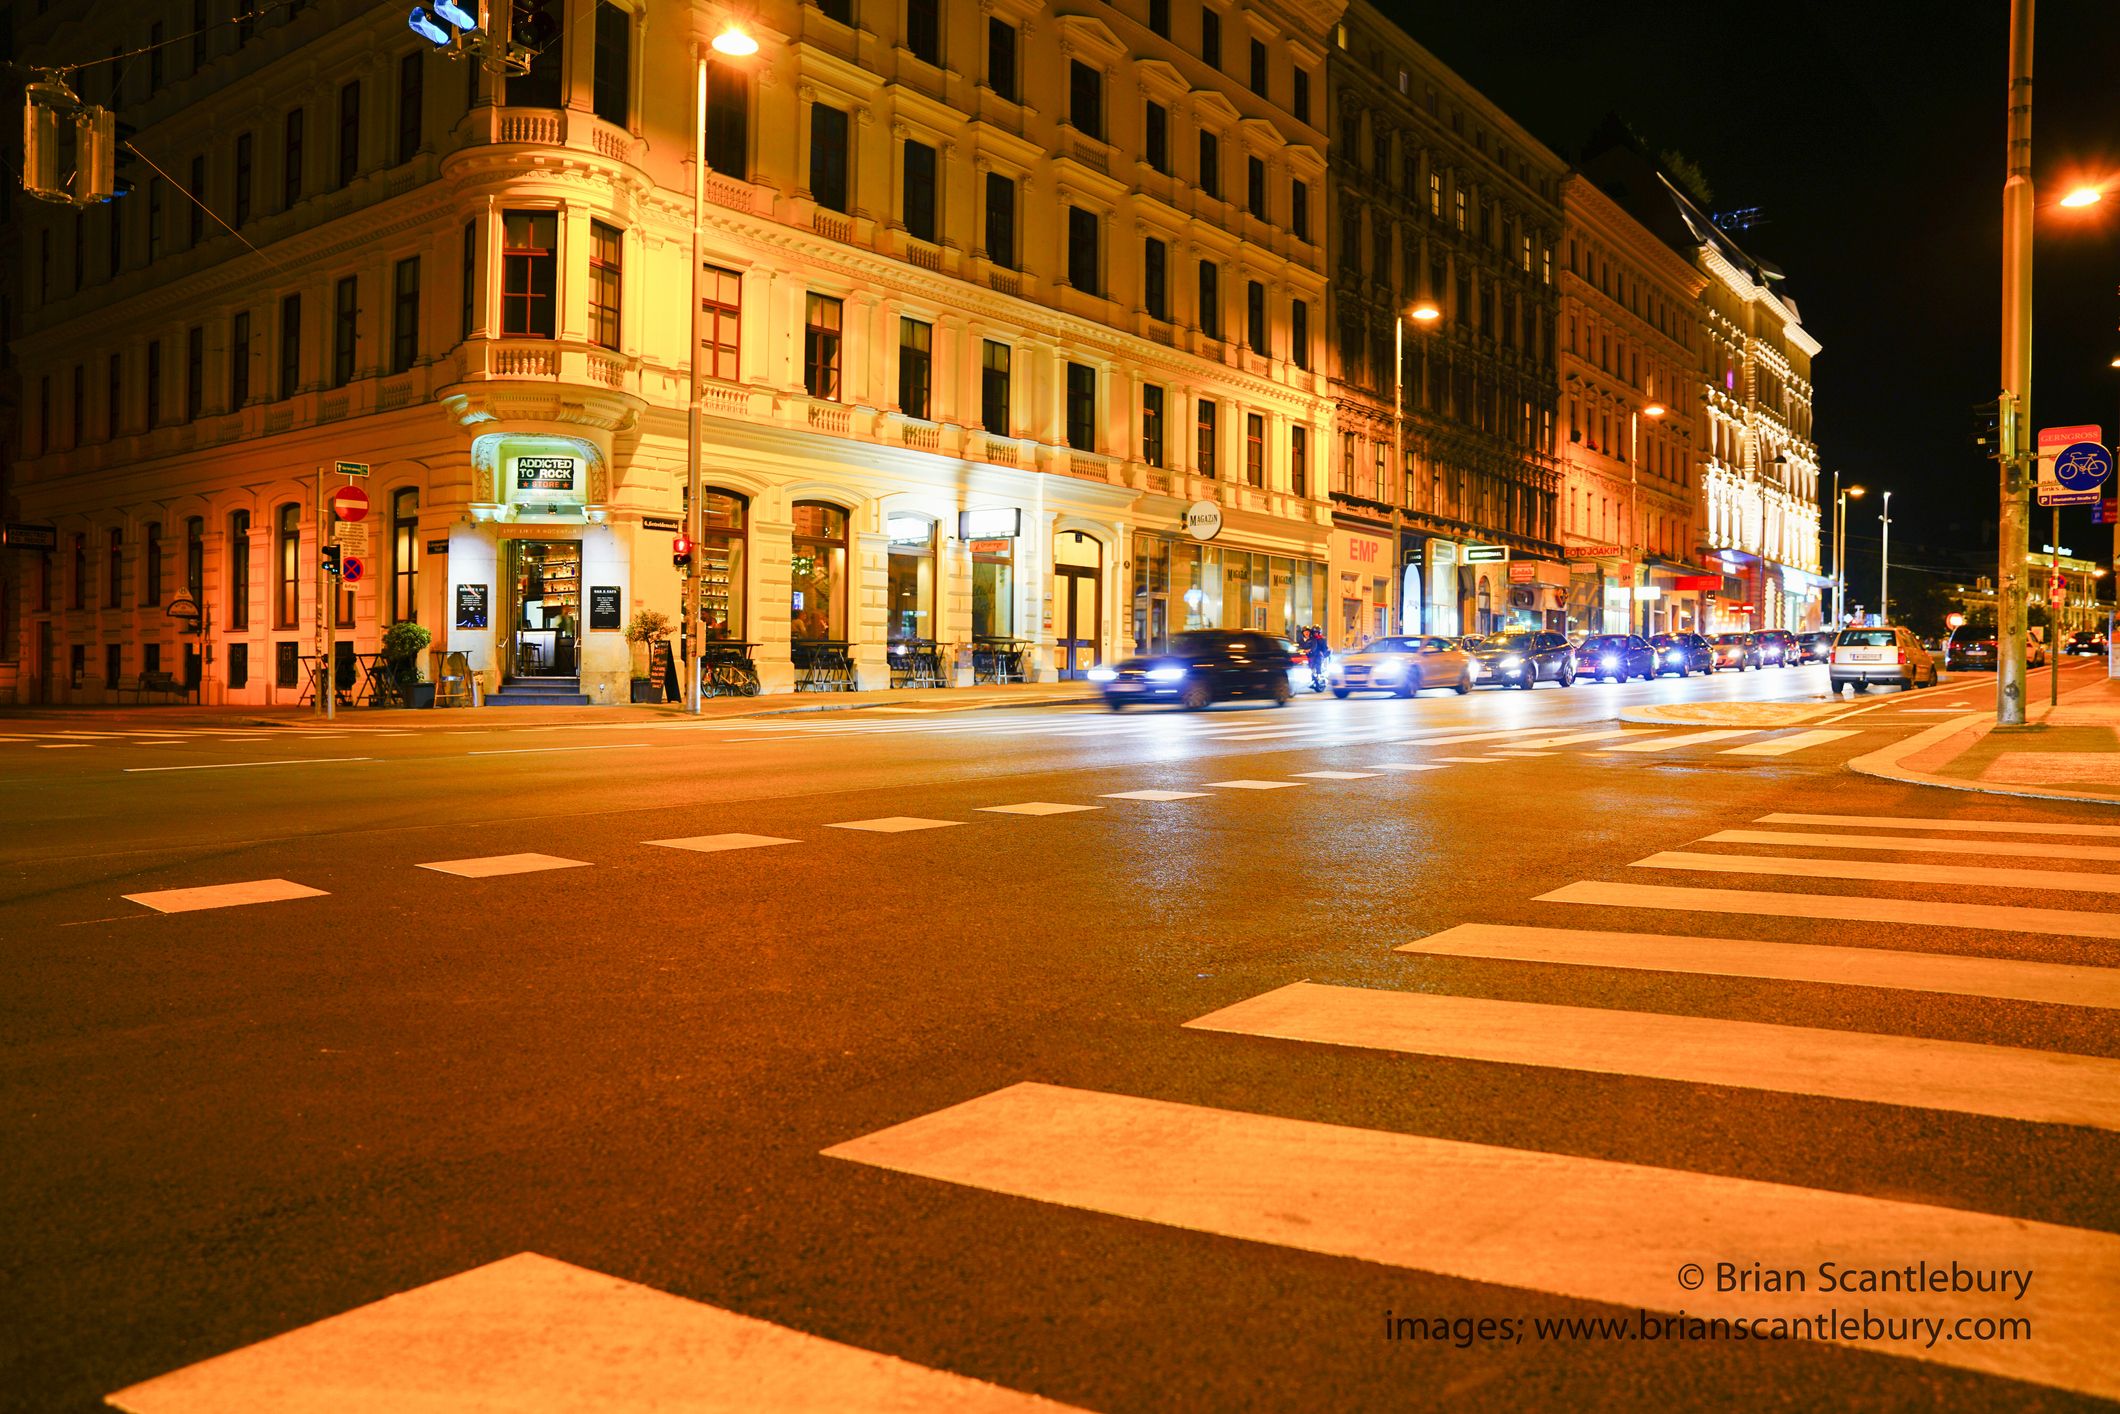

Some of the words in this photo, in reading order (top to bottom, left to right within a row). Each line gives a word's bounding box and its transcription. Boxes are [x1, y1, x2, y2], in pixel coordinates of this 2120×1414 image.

[2041, 431, 2098, 442] GERNGROSS
[519, 459, 573, 468] ADDICTED
[519, 469, 534, 478] TO
[539, 469, 571, 479] ROCK
[531, 480, 560, 488] STORE
[1349, 538, 1379, 563] EMP
